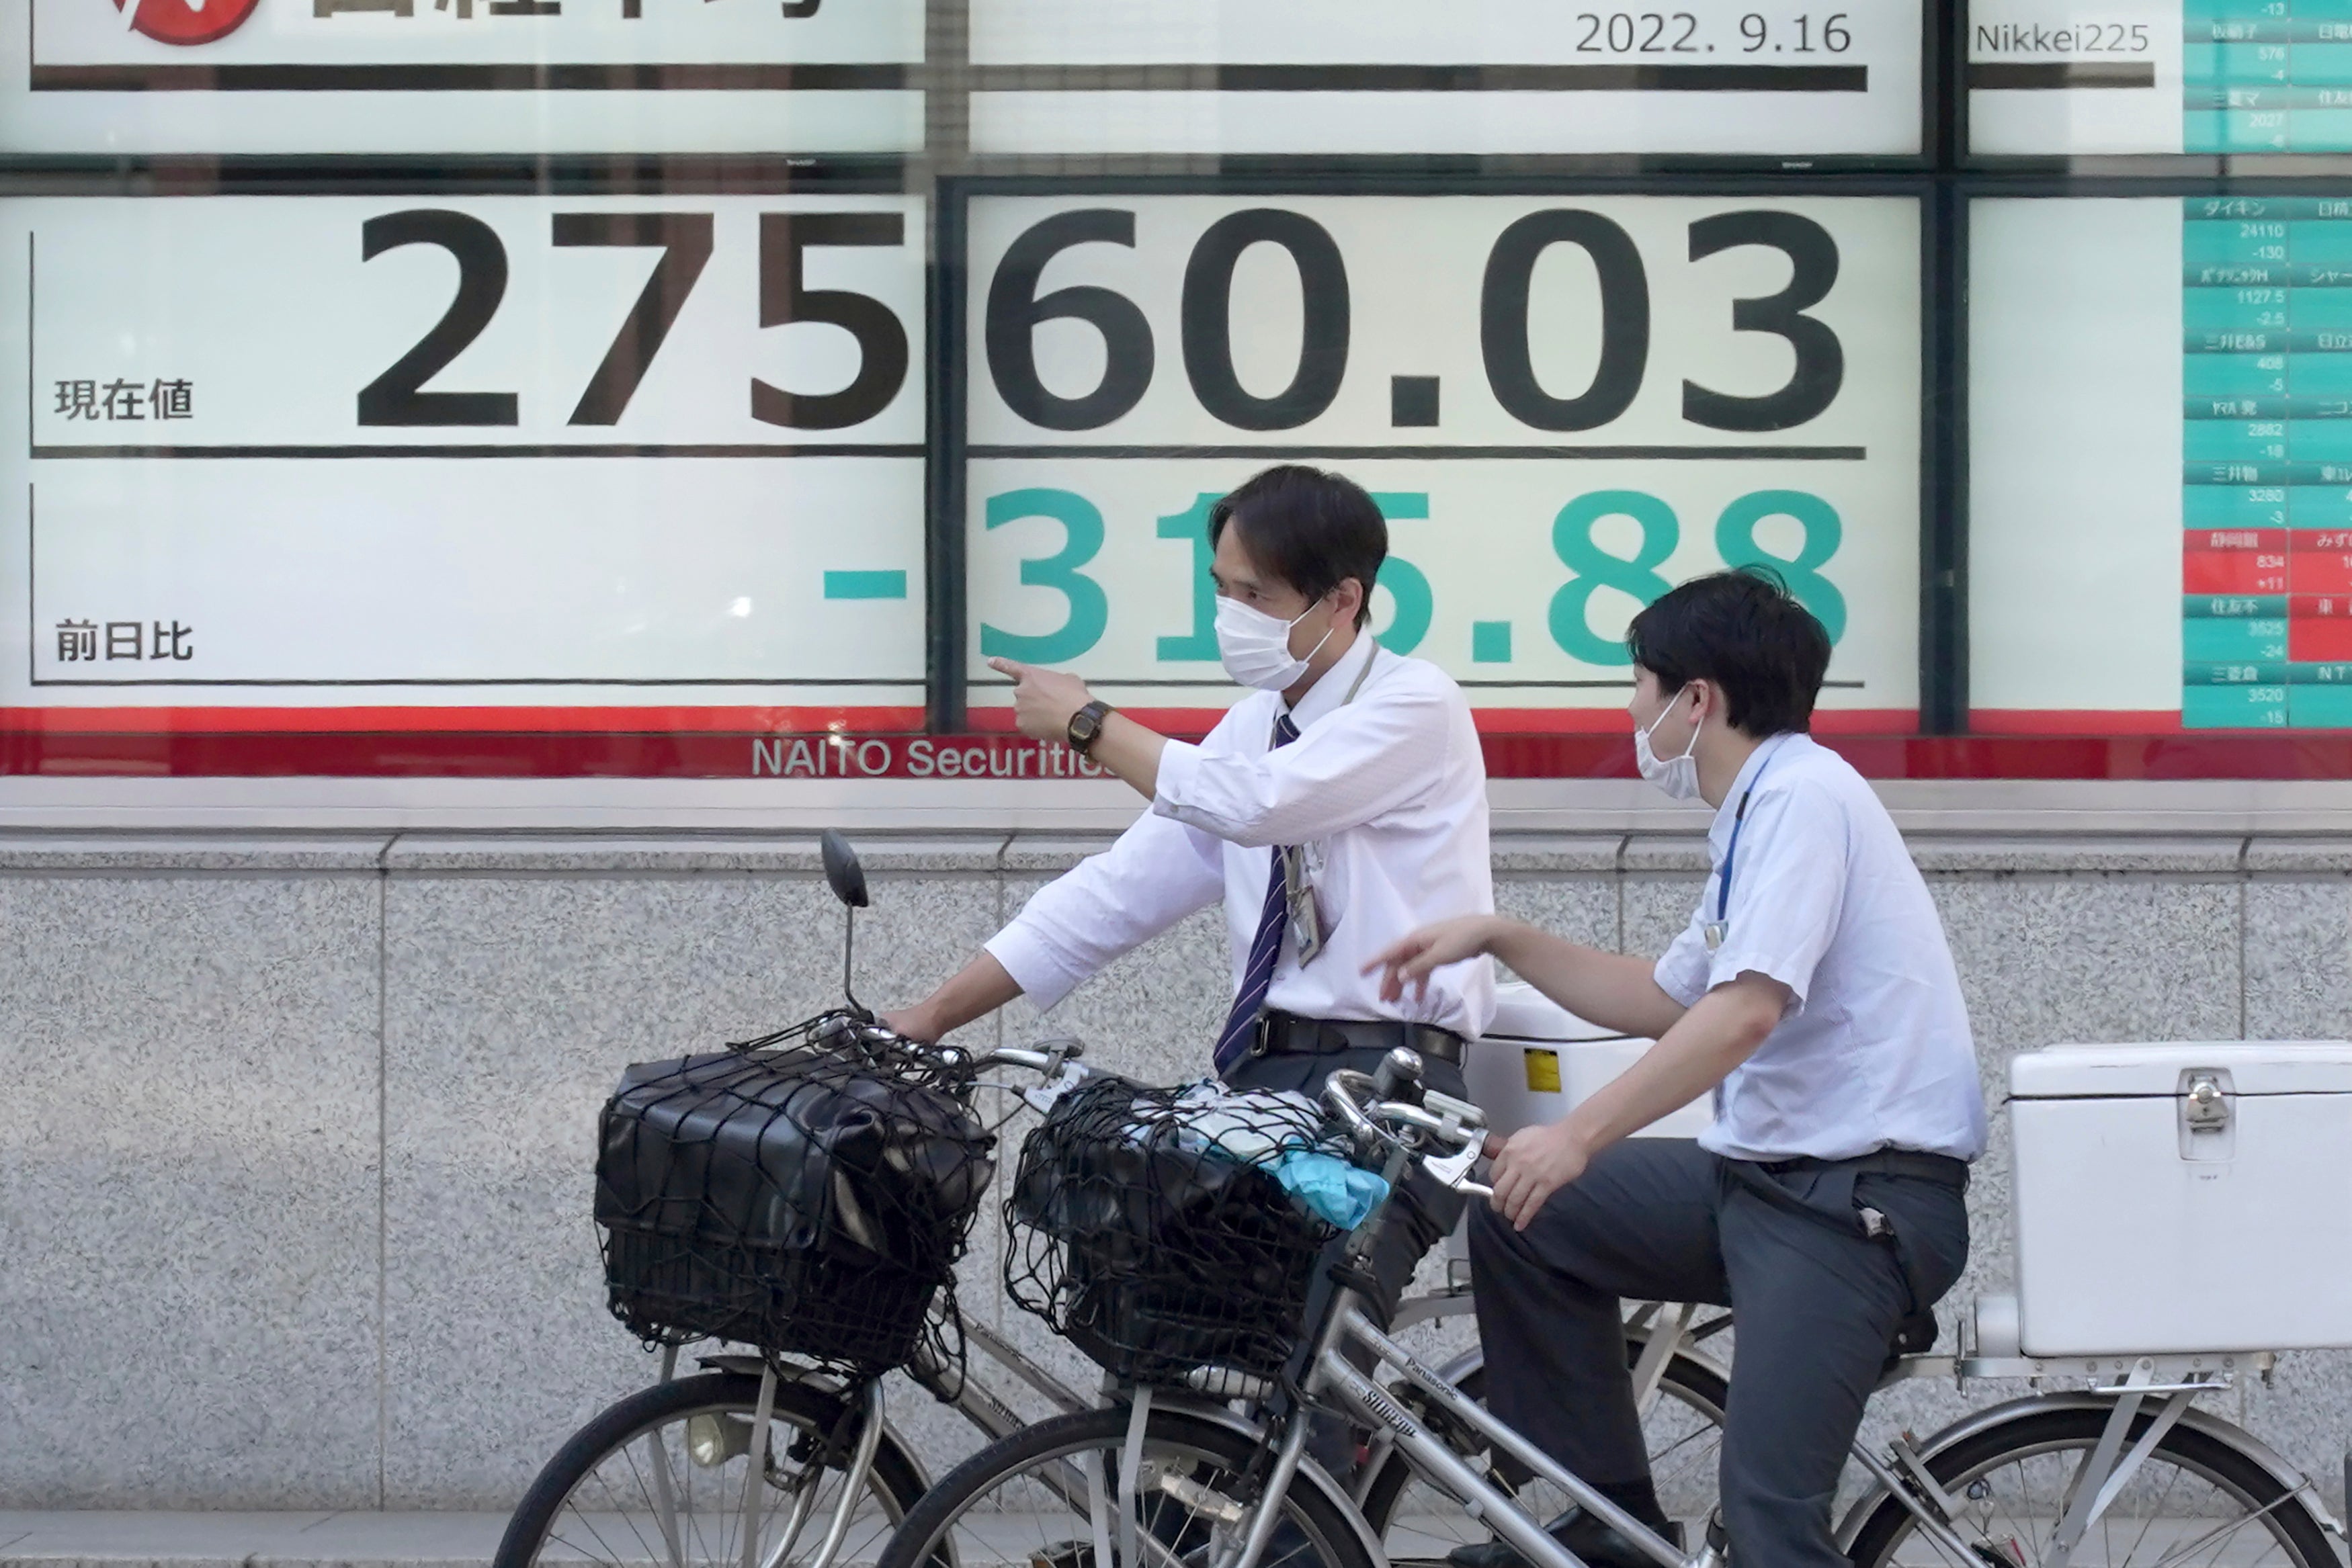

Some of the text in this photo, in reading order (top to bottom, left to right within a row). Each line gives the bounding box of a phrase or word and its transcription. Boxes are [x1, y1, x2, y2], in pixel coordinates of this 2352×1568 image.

[1576, 13, 1852, 53] 2022. 9.16
[1976, 24, 2149, 52] Nikkei225
[357, 208, 1845, 433] 27560.03
[54, 378, 194, 421] 現在値
[55, 617, 194, 662] 前日比
[752, 738, 1116, 777] NAITO Securitie
[1404, 1357, 1458, 1401] Panasonic
